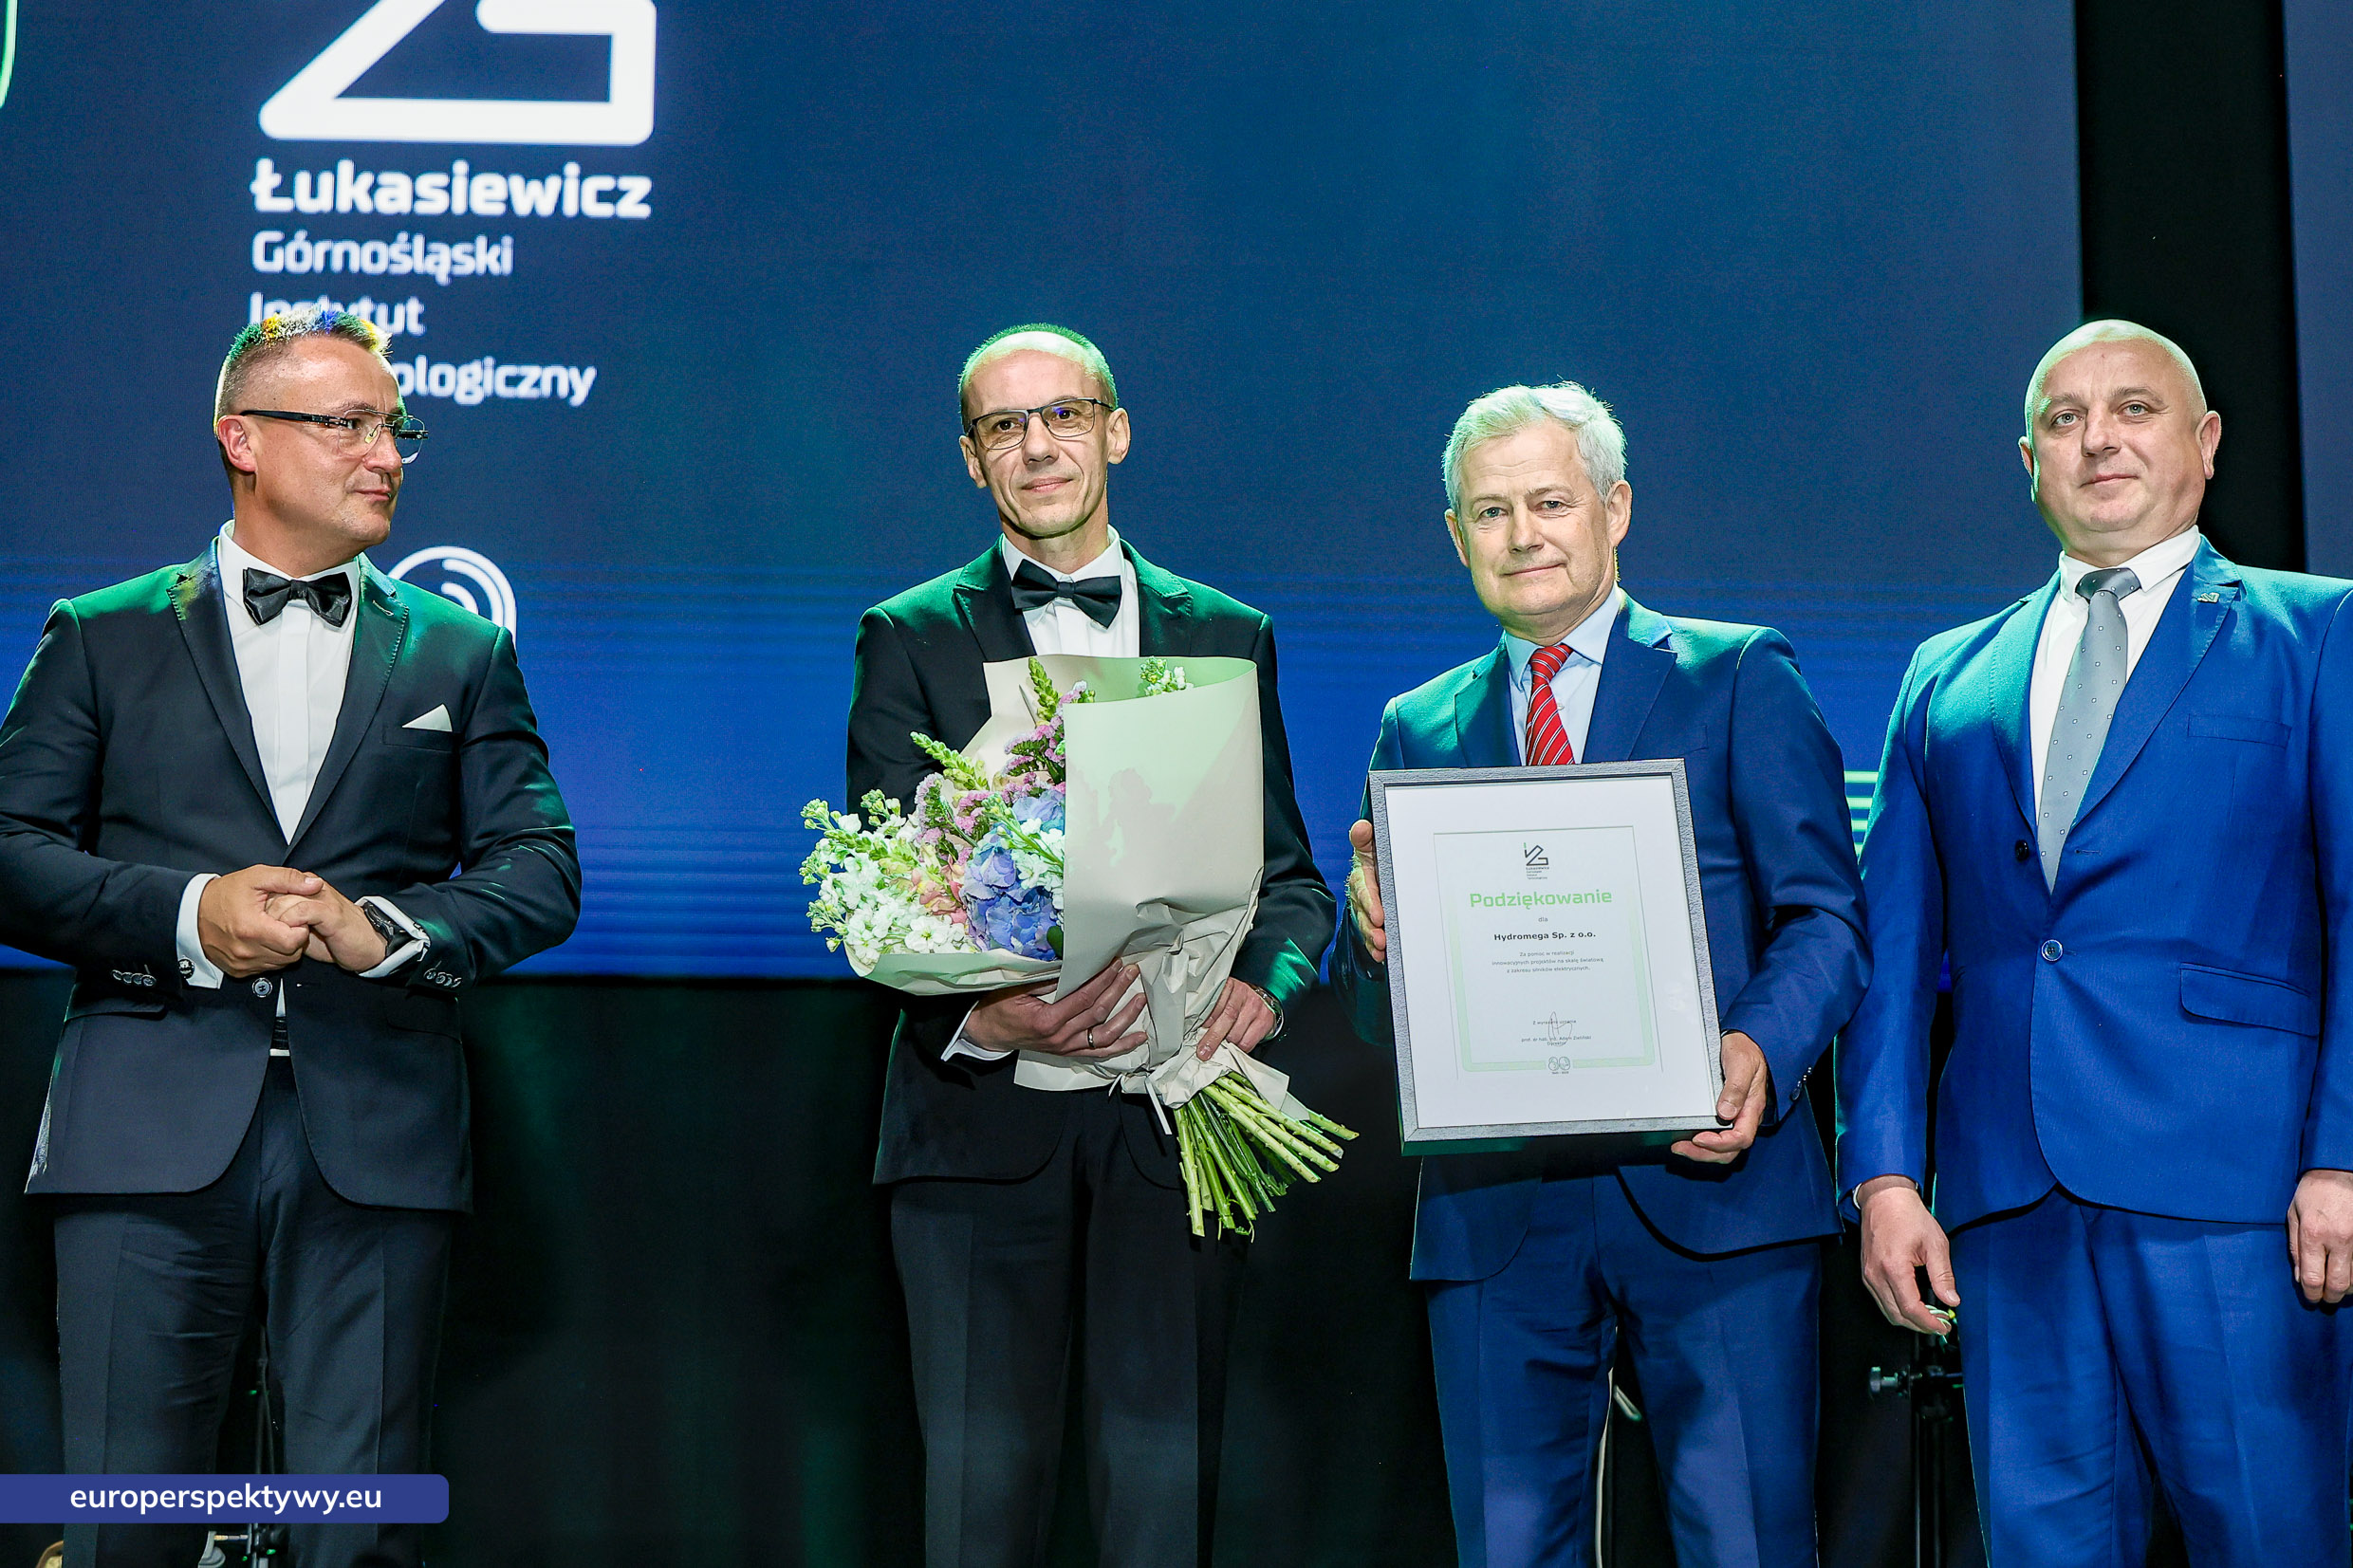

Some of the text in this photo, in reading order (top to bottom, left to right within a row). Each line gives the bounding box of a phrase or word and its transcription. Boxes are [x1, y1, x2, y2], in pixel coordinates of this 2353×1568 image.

[250, 157, 652, 219] Łukasiewicz
[251, 230, 514, 286] Górnośląski
[391, 355, 598, 407] ologiczny
[1470, 889, 1612, 910] Podziękowanie
[1493, 932, 1549, 942] Hydromega
[1551, 932, 1567, 940] Sp.
